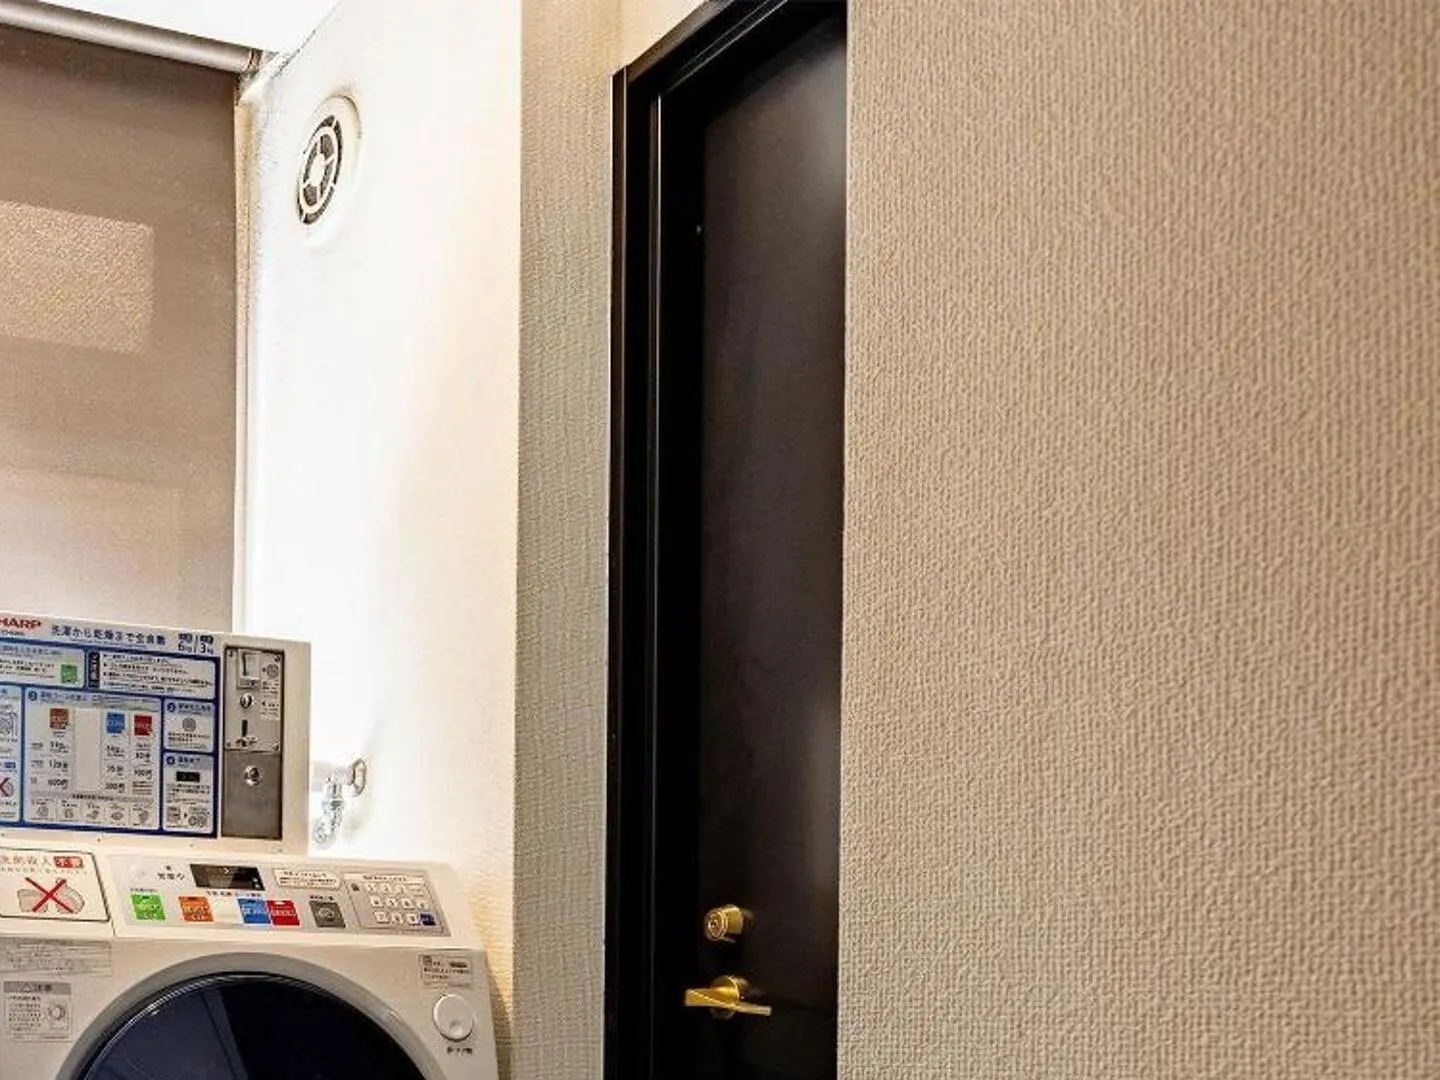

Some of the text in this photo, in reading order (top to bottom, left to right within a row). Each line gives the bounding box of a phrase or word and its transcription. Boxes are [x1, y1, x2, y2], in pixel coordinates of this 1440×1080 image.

[51, 624, 166, 646] 洗濯から乾燥まで全自動
